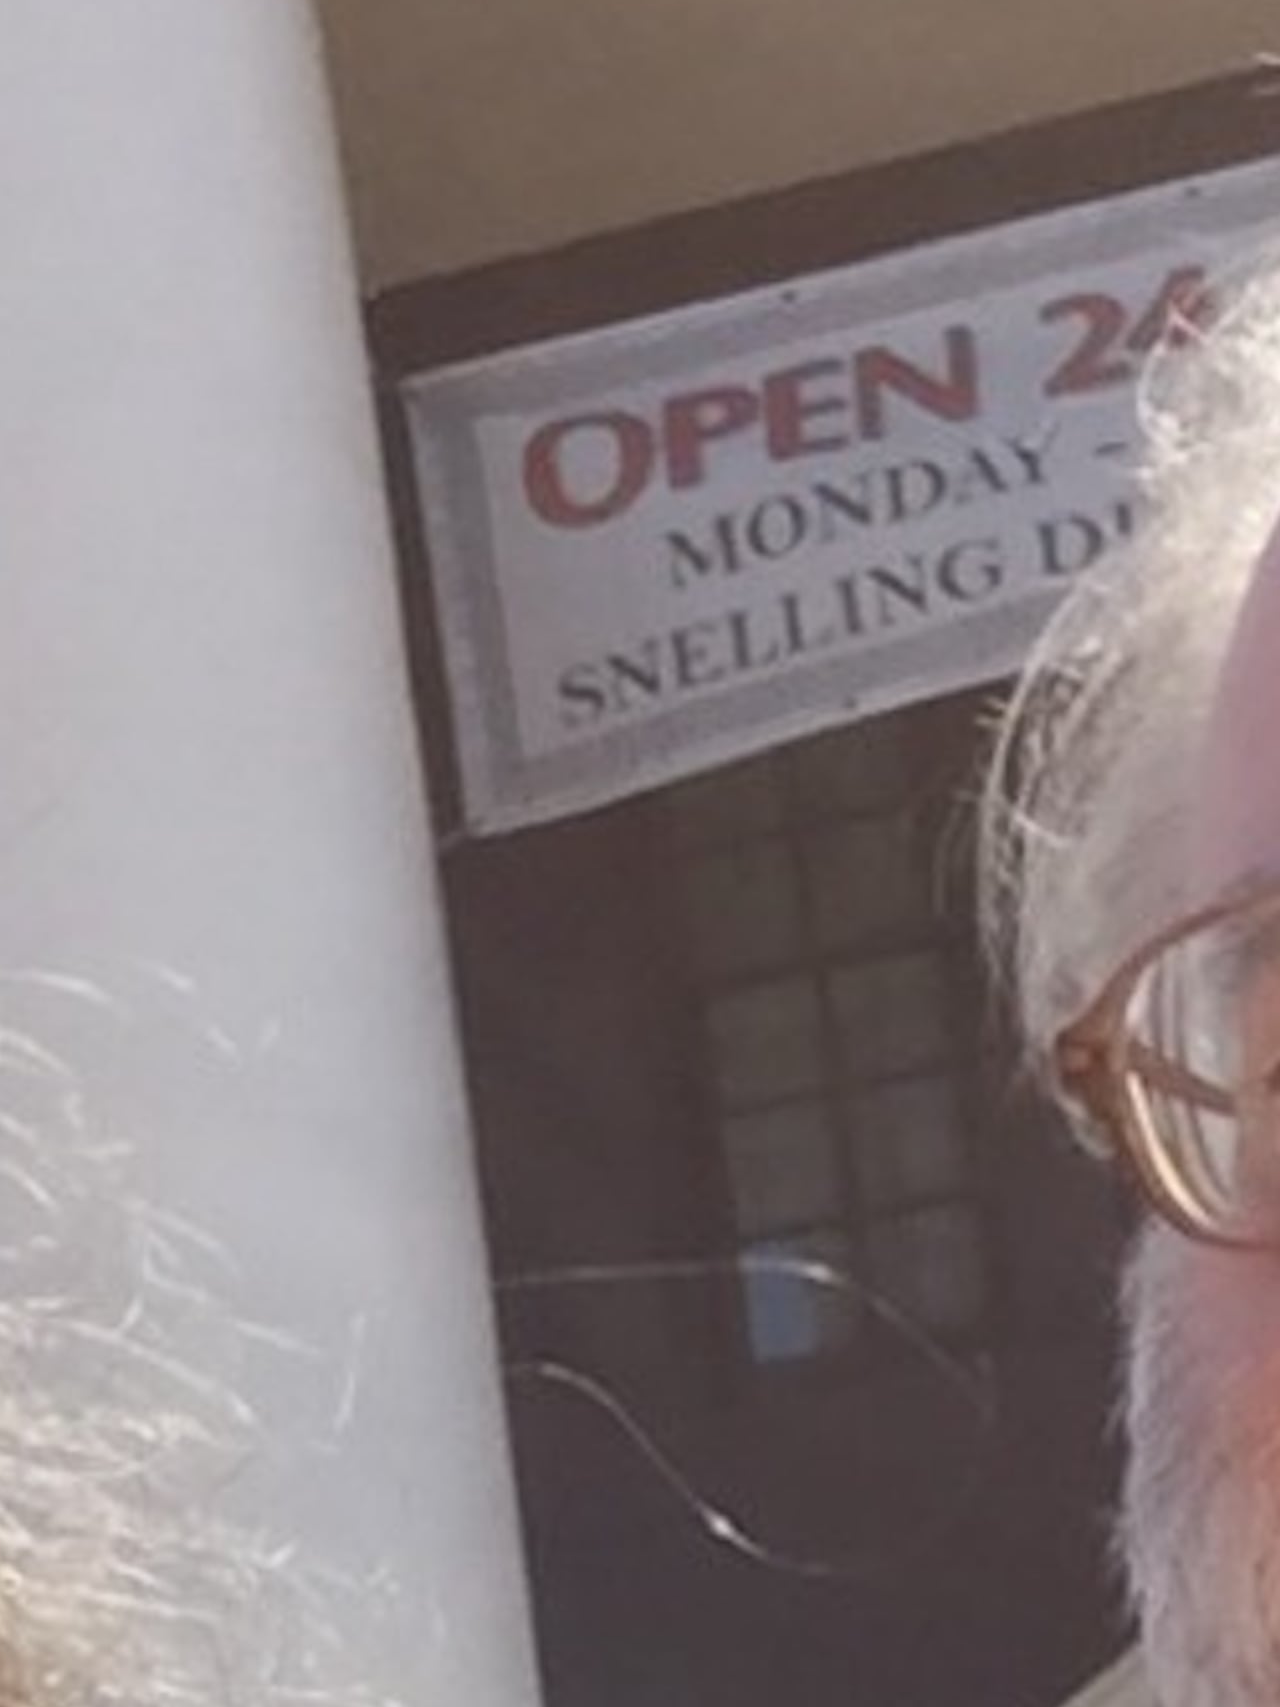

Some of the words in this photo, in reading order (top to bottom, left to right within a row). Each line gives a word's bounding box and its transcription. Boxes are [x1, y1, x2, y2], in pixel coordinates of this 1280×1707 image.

[521, 325, 980, 530] OPEN
[665, 420, 1060, 589] MONDAY
[557, 536, 1003, 732] SNELLING
